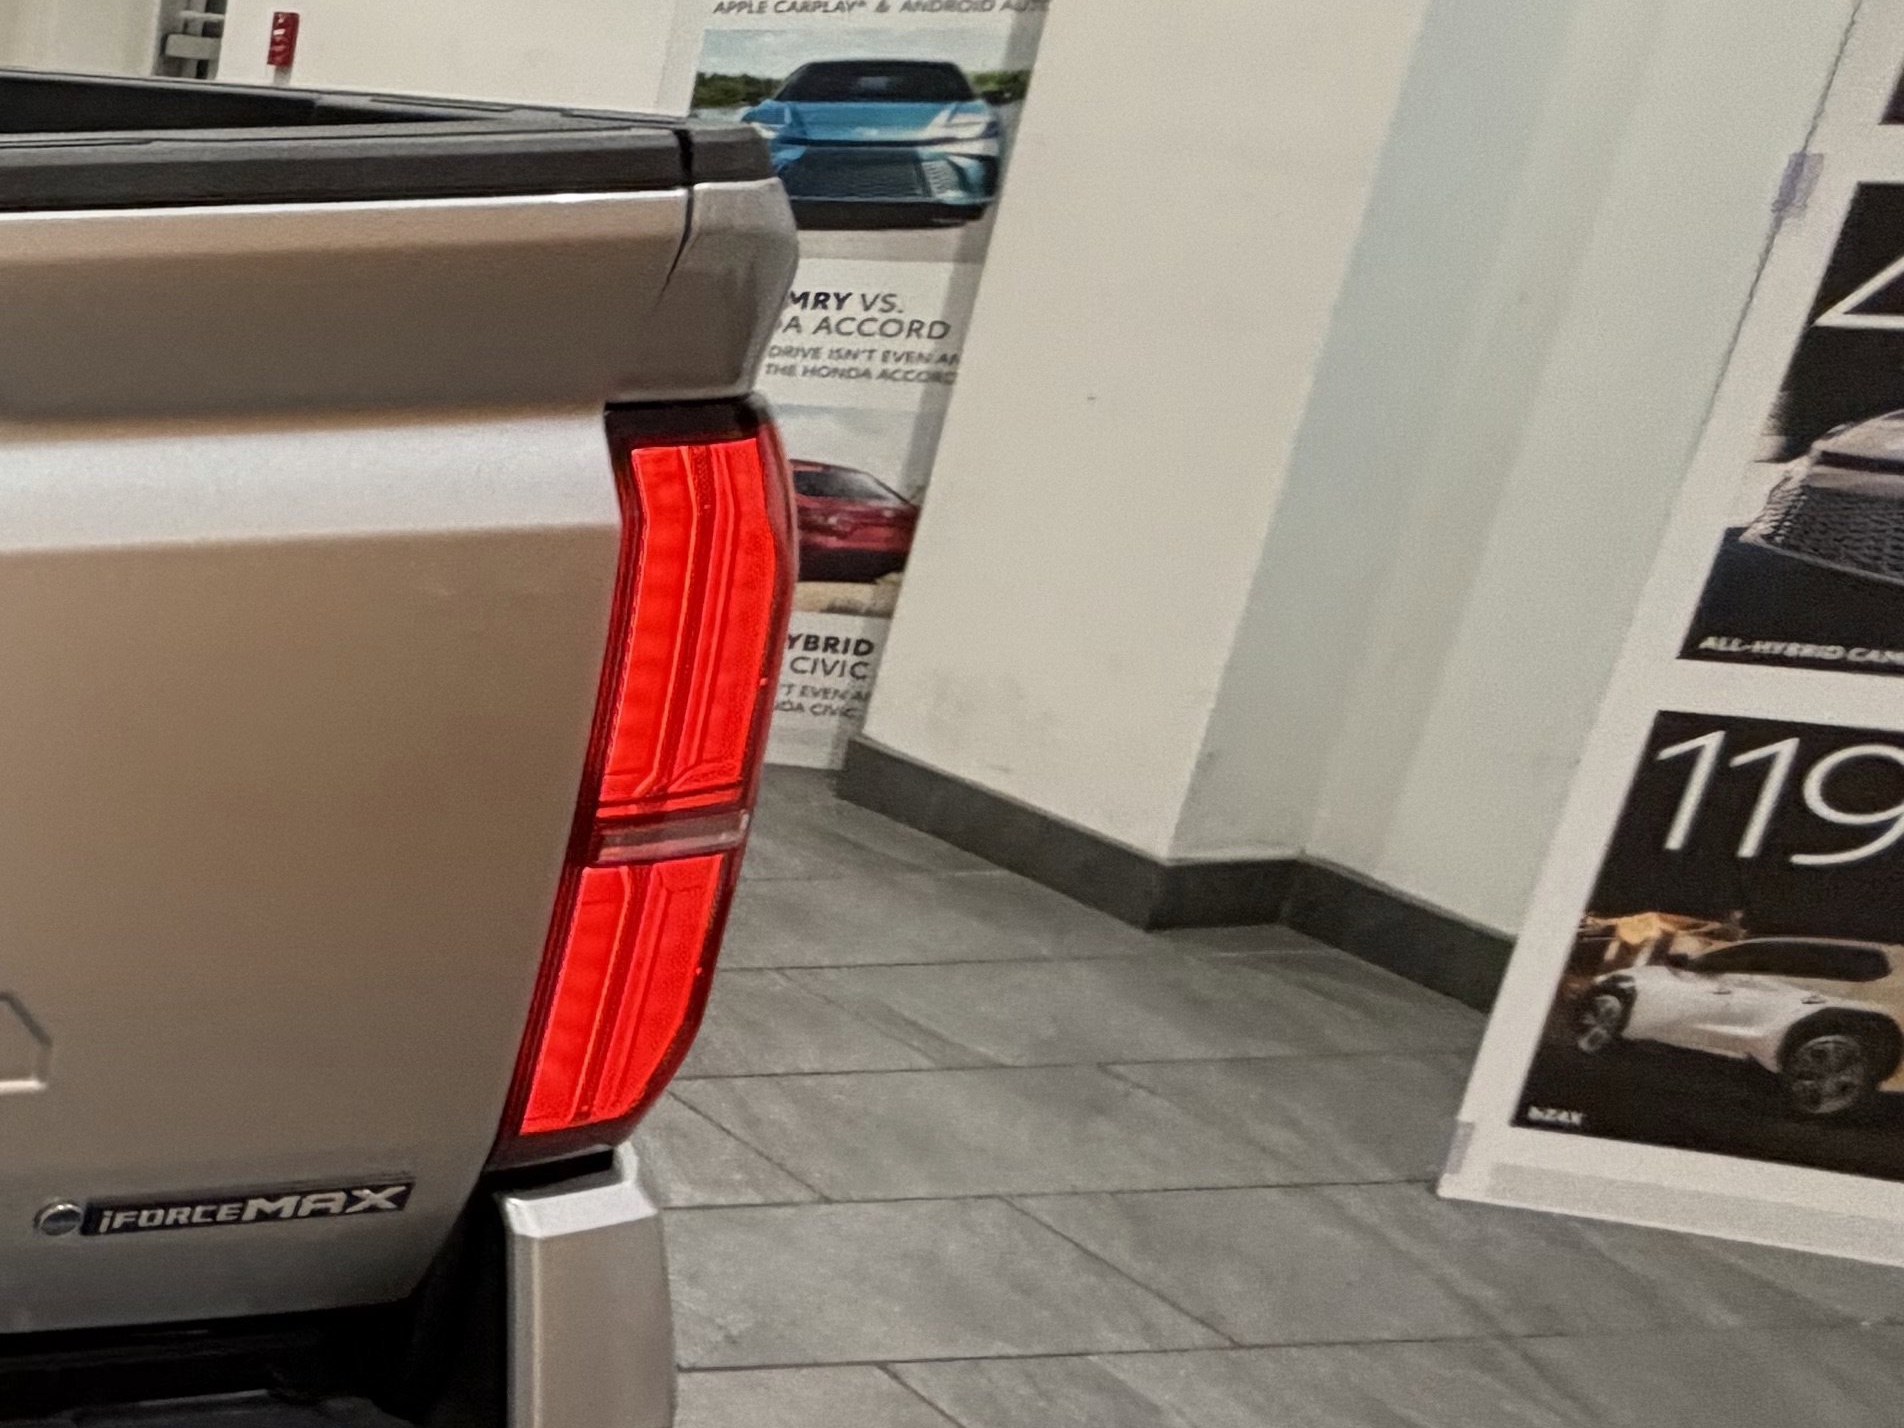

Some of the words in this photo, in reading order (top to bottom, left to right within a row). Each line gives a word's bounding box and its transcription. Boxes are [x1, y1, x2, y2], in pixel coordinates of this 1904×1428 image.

[790, 290, 853, 311] MRY
[860, 292, 904, 314] VS.
[812, 315, 952, 340] ACCORD
[787, 632, 875, 658] YBRID
[789, 656, 871, 680] CIVIC
